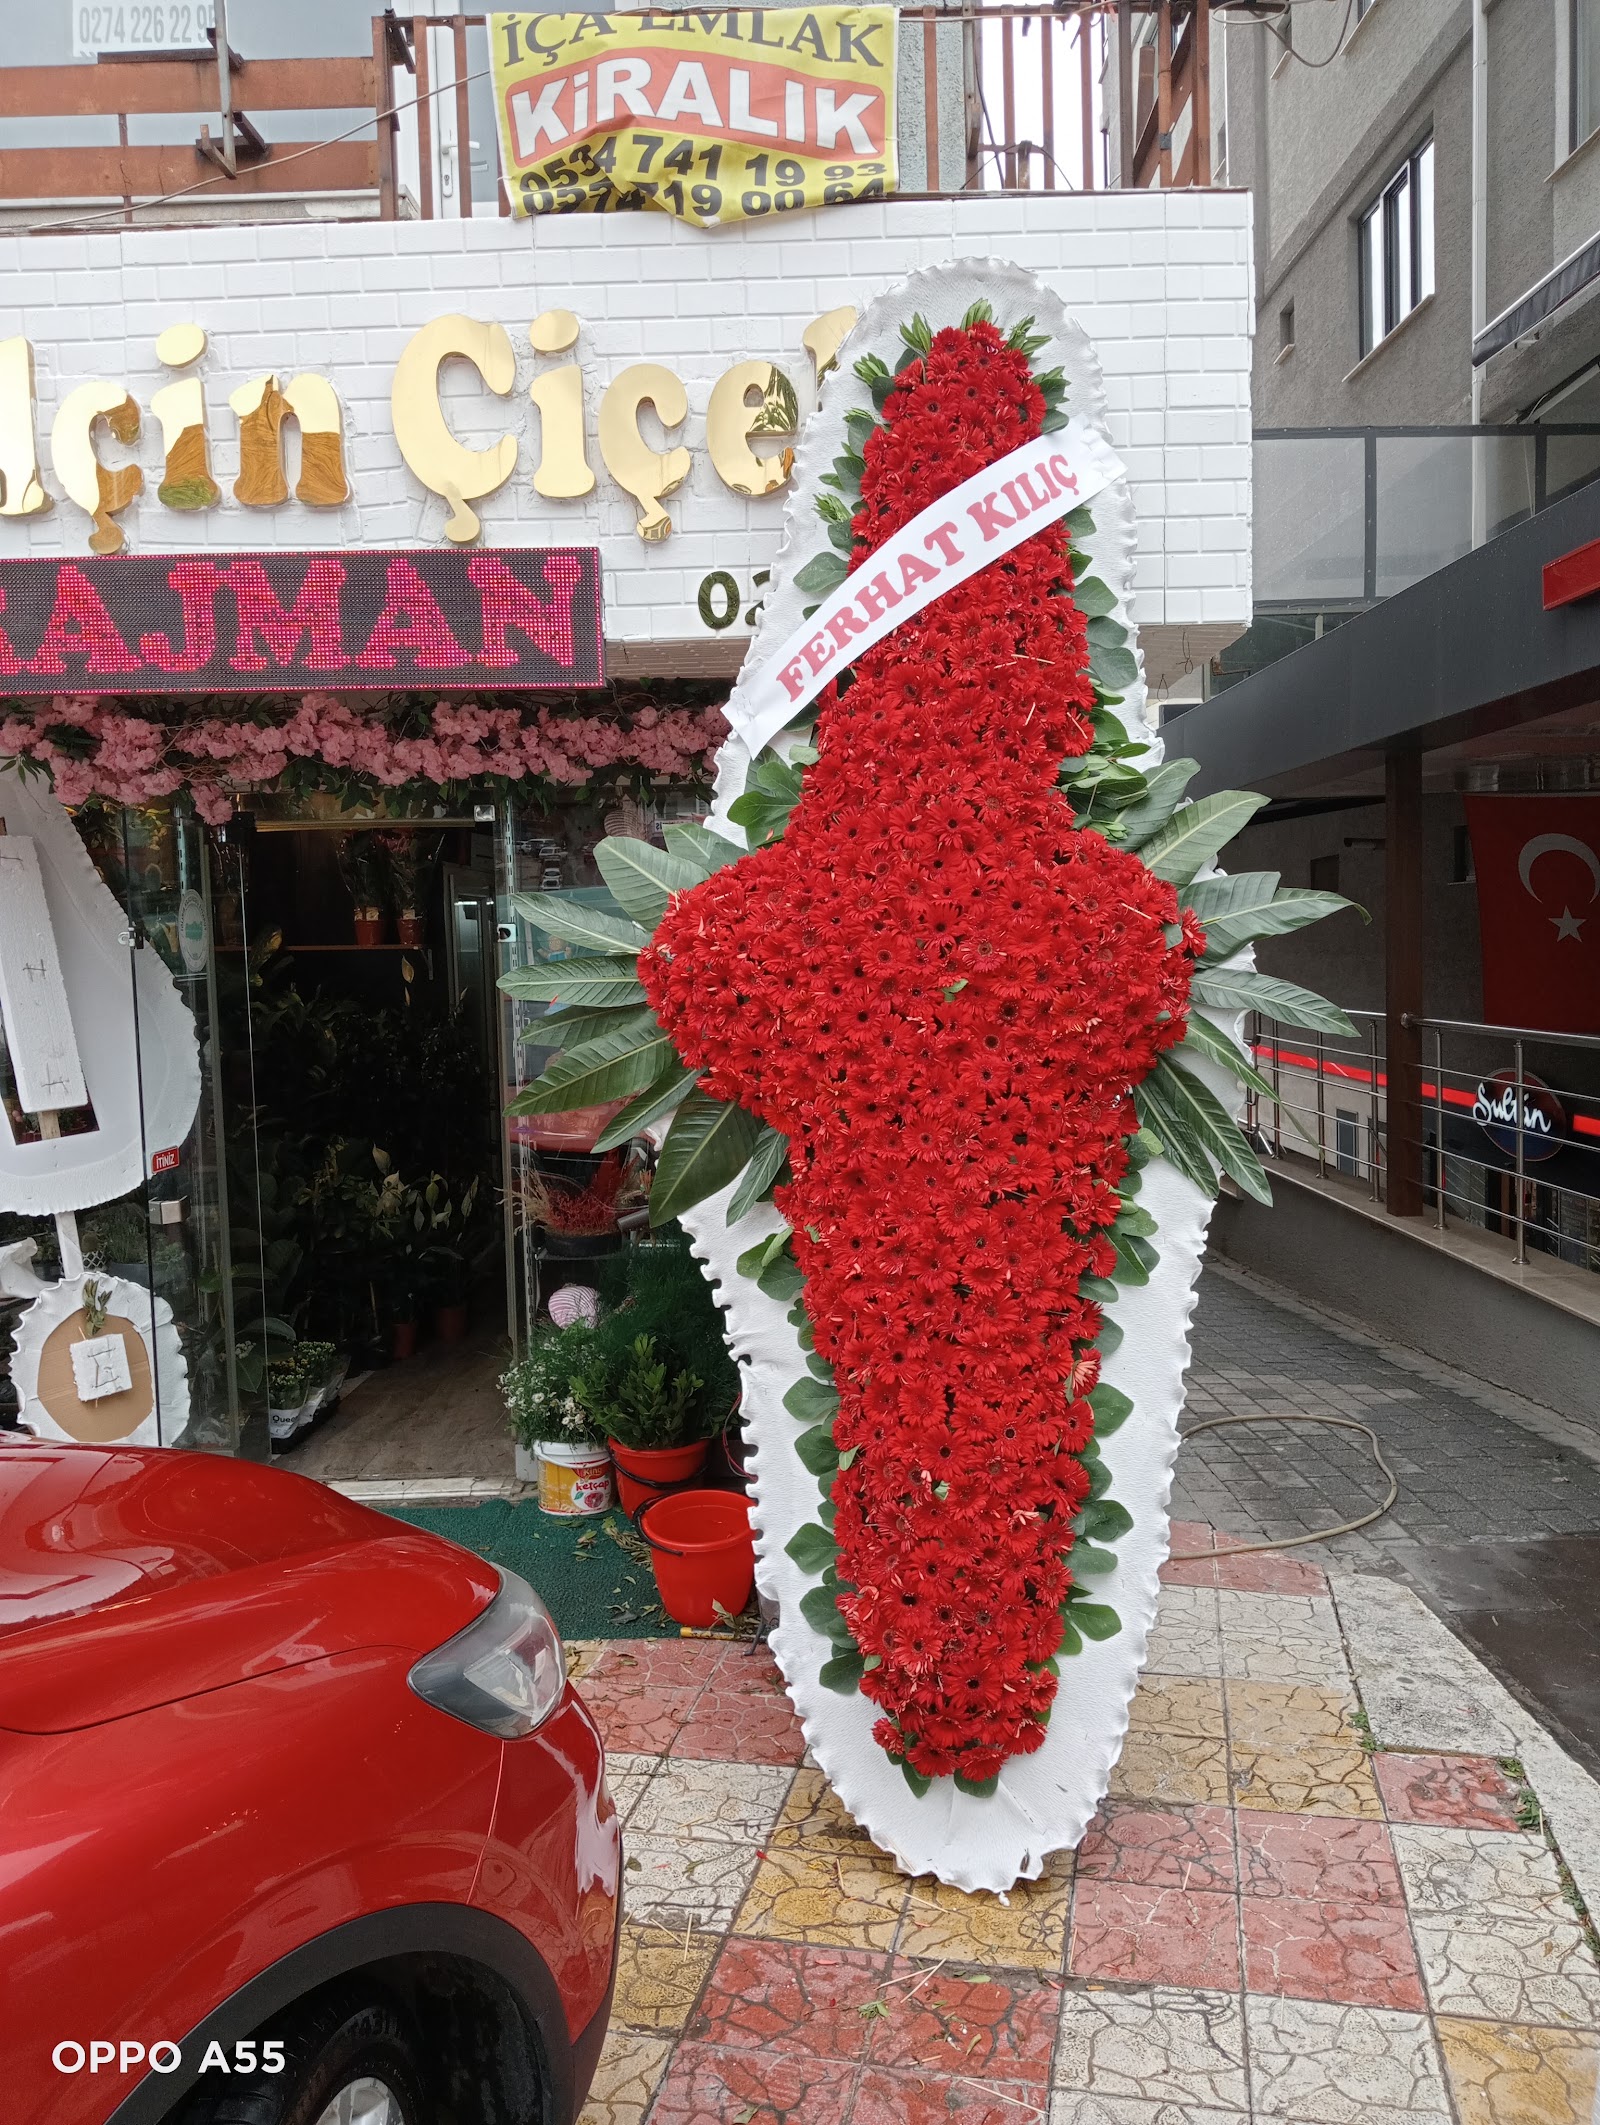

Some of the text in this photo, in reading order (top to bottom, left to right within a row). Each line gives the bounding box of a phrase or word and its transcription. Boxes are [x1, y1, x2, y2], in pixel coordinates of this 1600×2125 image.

[79, 6, 125, 43] 0274
[130, 5, 164, 43] 226
[169, 5, 192, 43] 22
[632, 134, 723, 180] 741
[745, 153, 805, 187] 19
[824, 163, 887, 181] 93
[741, 189, 805, 217] 00
[776, 454, 1080, 703] FERHAT KILIÇ
[0, 557, 577, 675] AJMAN
